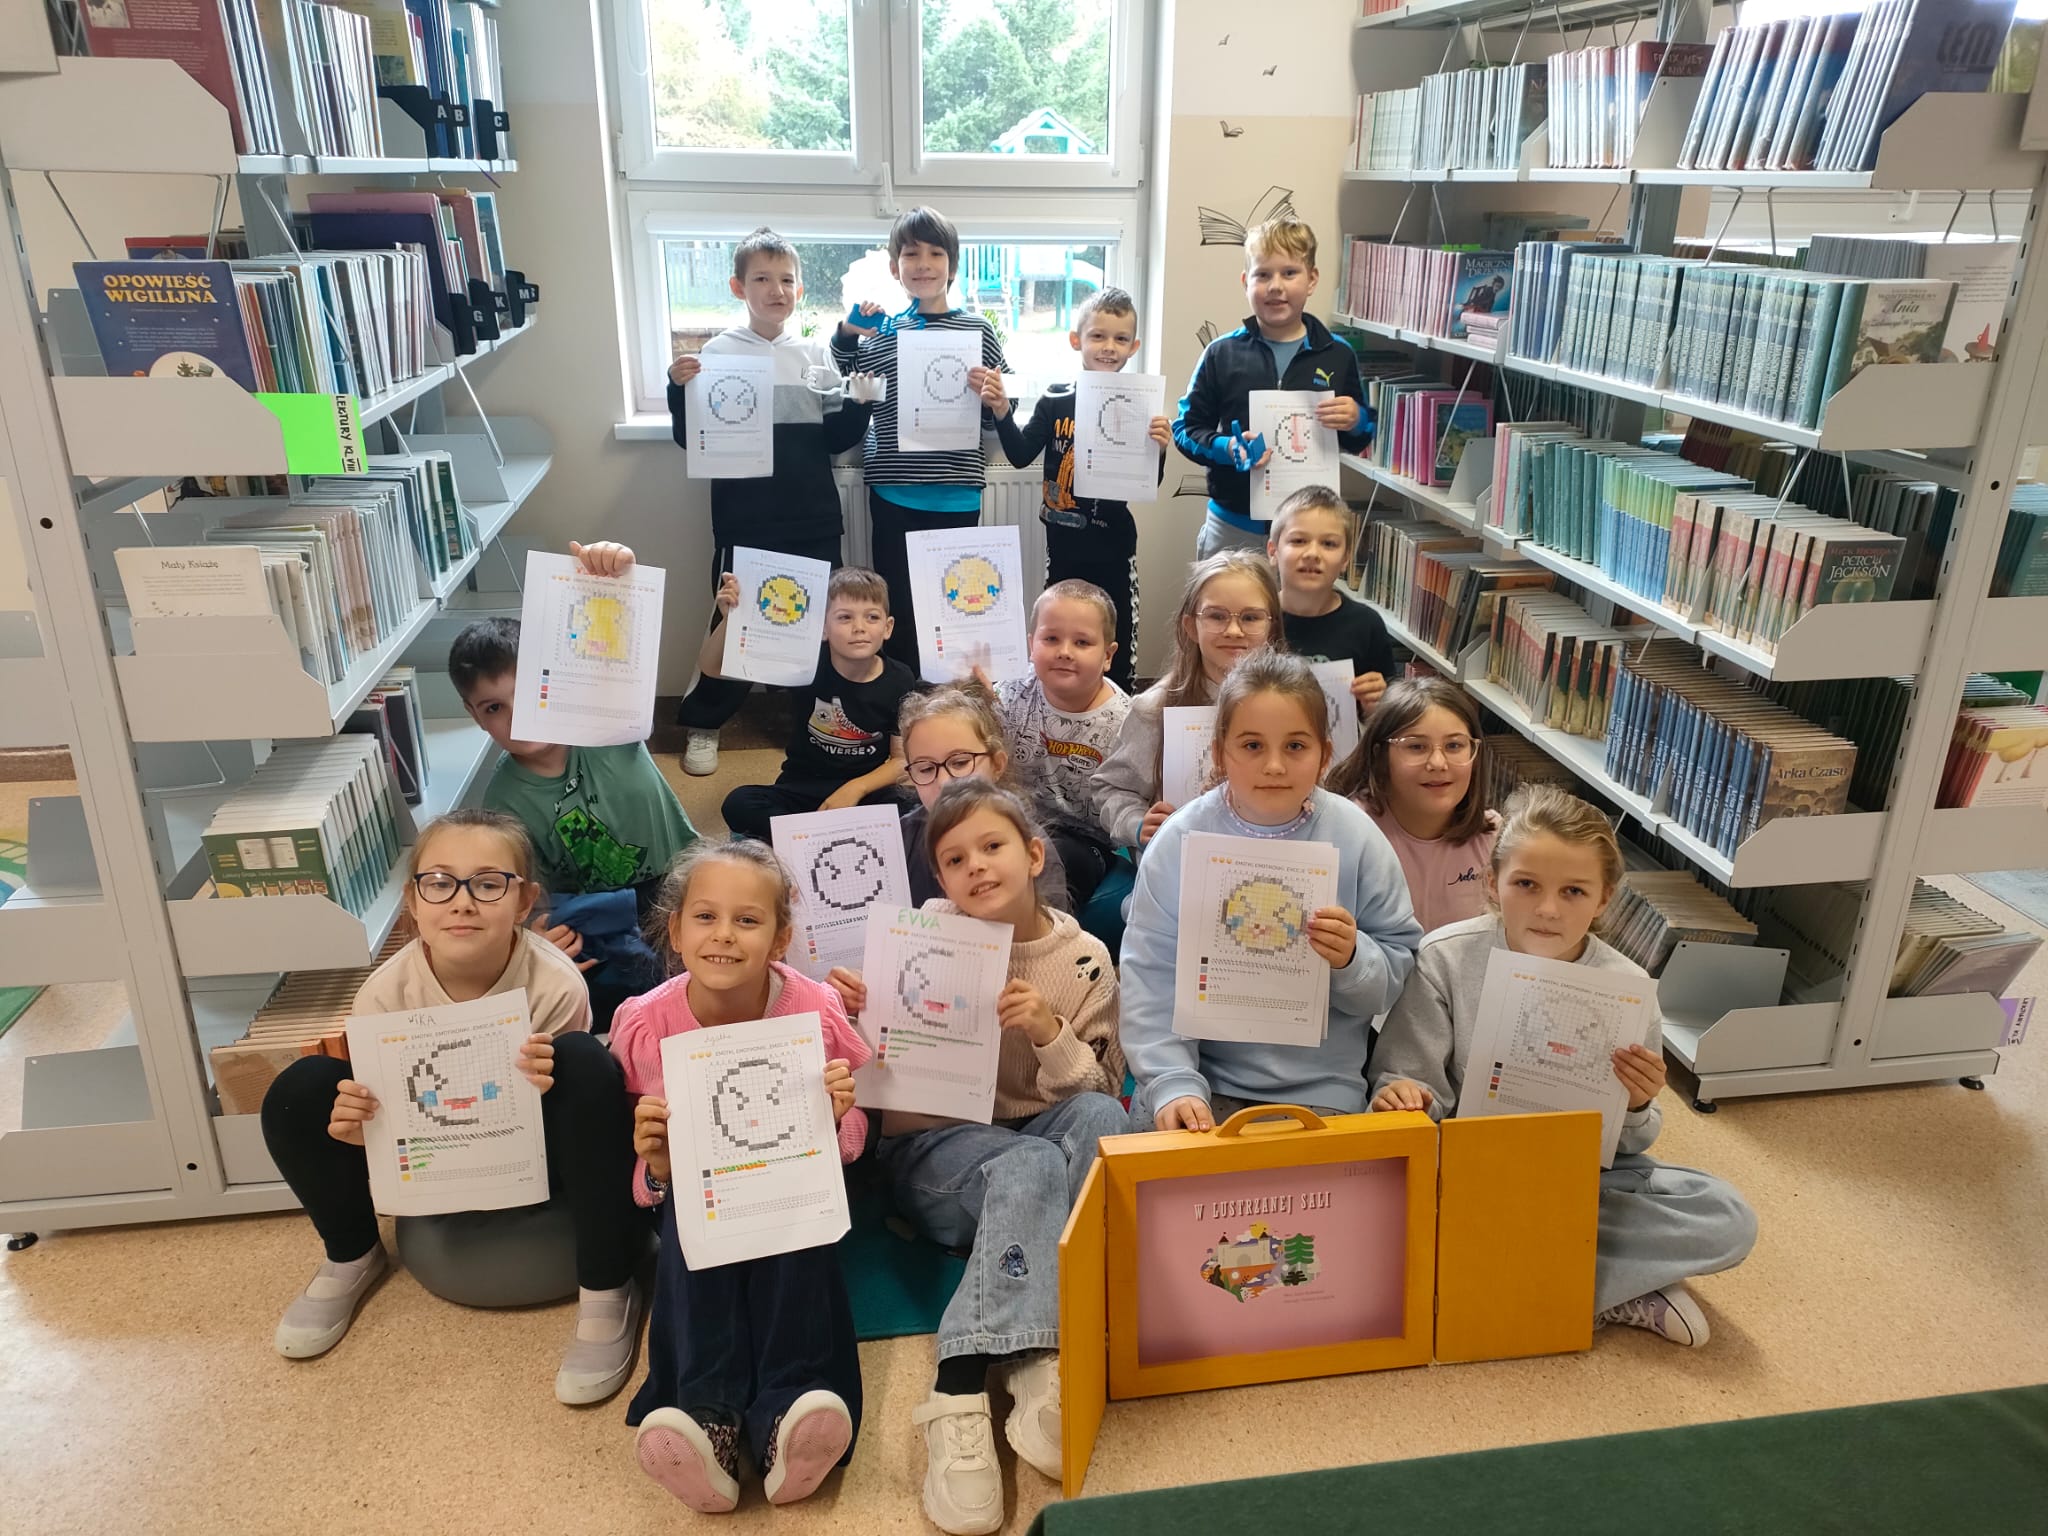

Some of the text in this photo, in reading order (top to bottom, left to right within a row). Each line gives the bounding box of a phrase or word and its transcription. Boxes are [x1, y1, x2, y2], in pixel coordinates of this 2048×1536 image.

[437, 105, 448, 119] A
[454, 109, 464, 122] B
[494, 115, 503, 128] C
[103, 271, 212, 289] OPOWIEŚĆ
[103, 289, 218, 304] WIGILIJNA
[518, 288, 530, 300] M
[494, 296, 506, 308] K
[473, 310, 484, 322] G
[335, 395, 352, 440] LEKTURY
[1841, 555, 1883, 569] PERCY
[1827, 564, 1891, 583] JACKSON
[1776, 766, 1847, 779] Arka Czasu
[1194, 1191, 1332, 1221] W LUSTRZANEJ SALI
